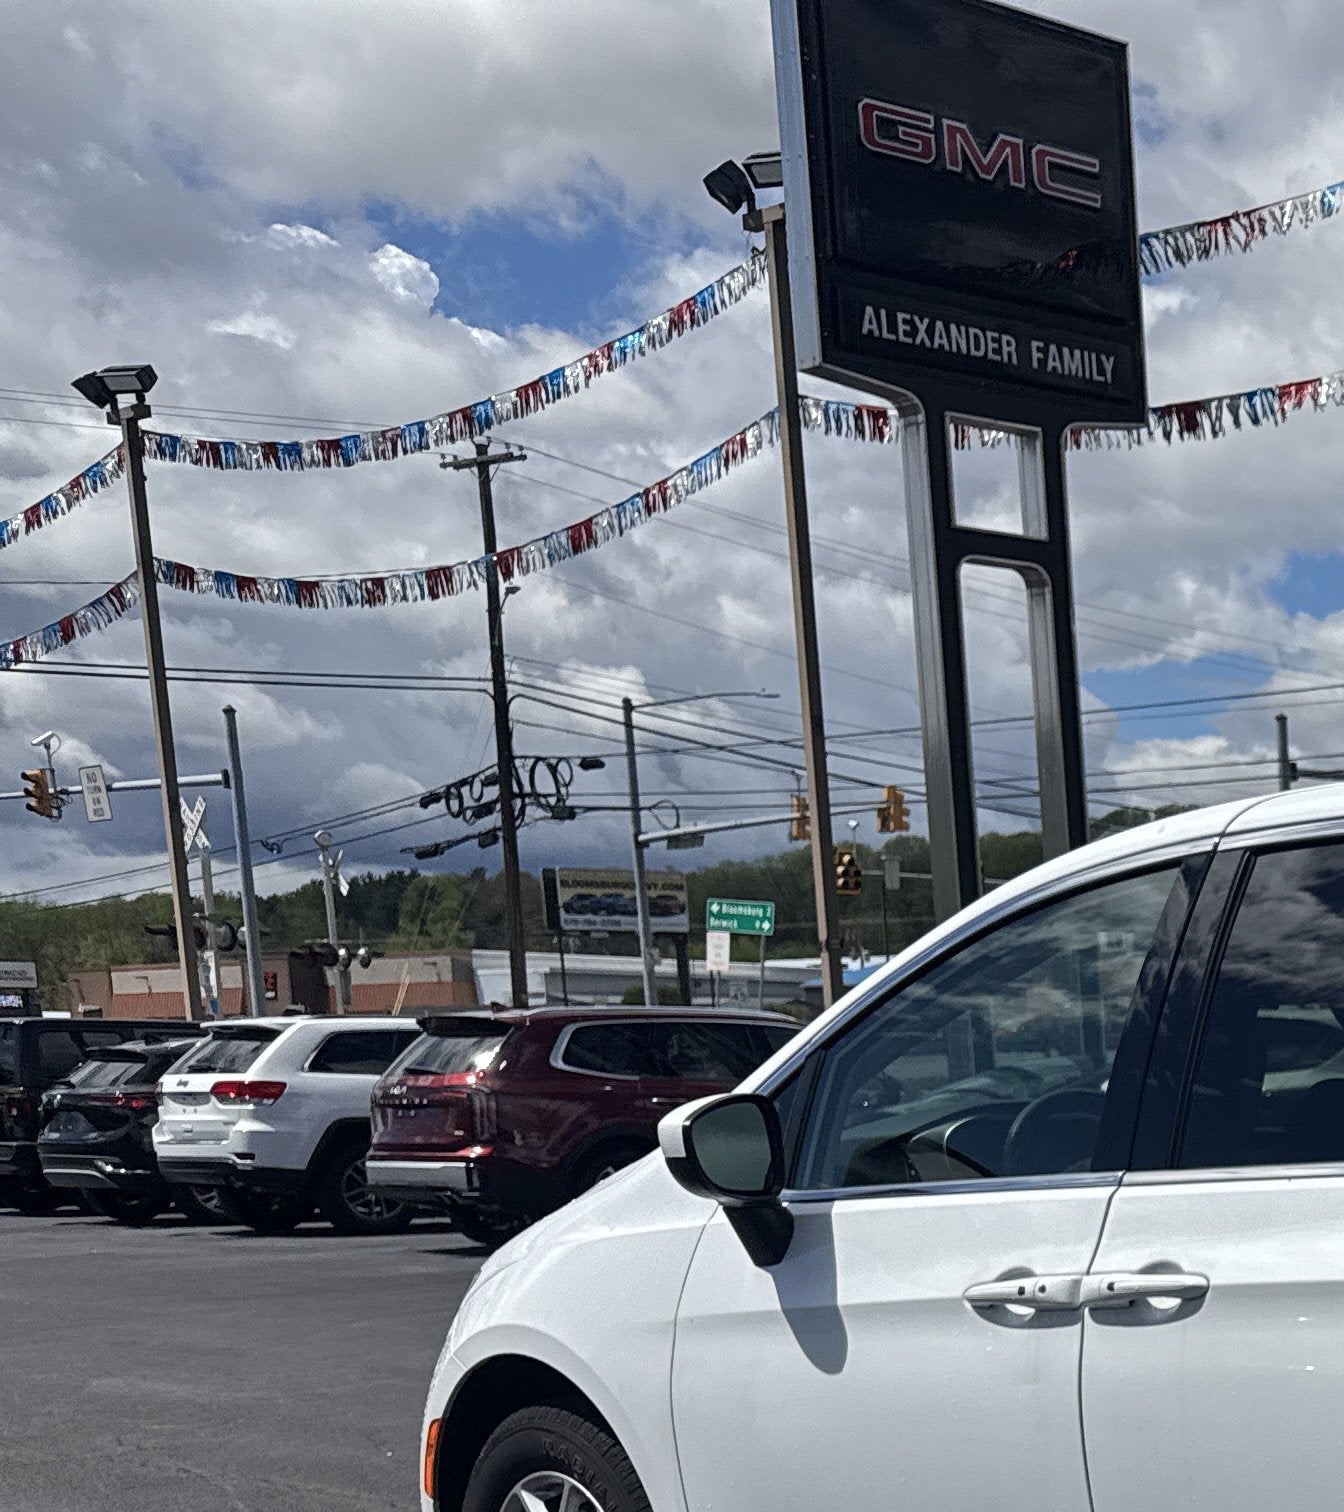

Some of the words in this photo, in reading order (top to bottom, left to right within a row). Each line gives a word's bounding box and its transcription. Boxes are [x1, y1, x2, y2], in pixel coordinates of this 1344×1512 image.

[858, 98, 1101, 208] GMC
[862, 305, 1018, 366] ALEXANDER
[1031, 340, 1116, 384] FAMILY
[86, 771, 98, 784] NO
